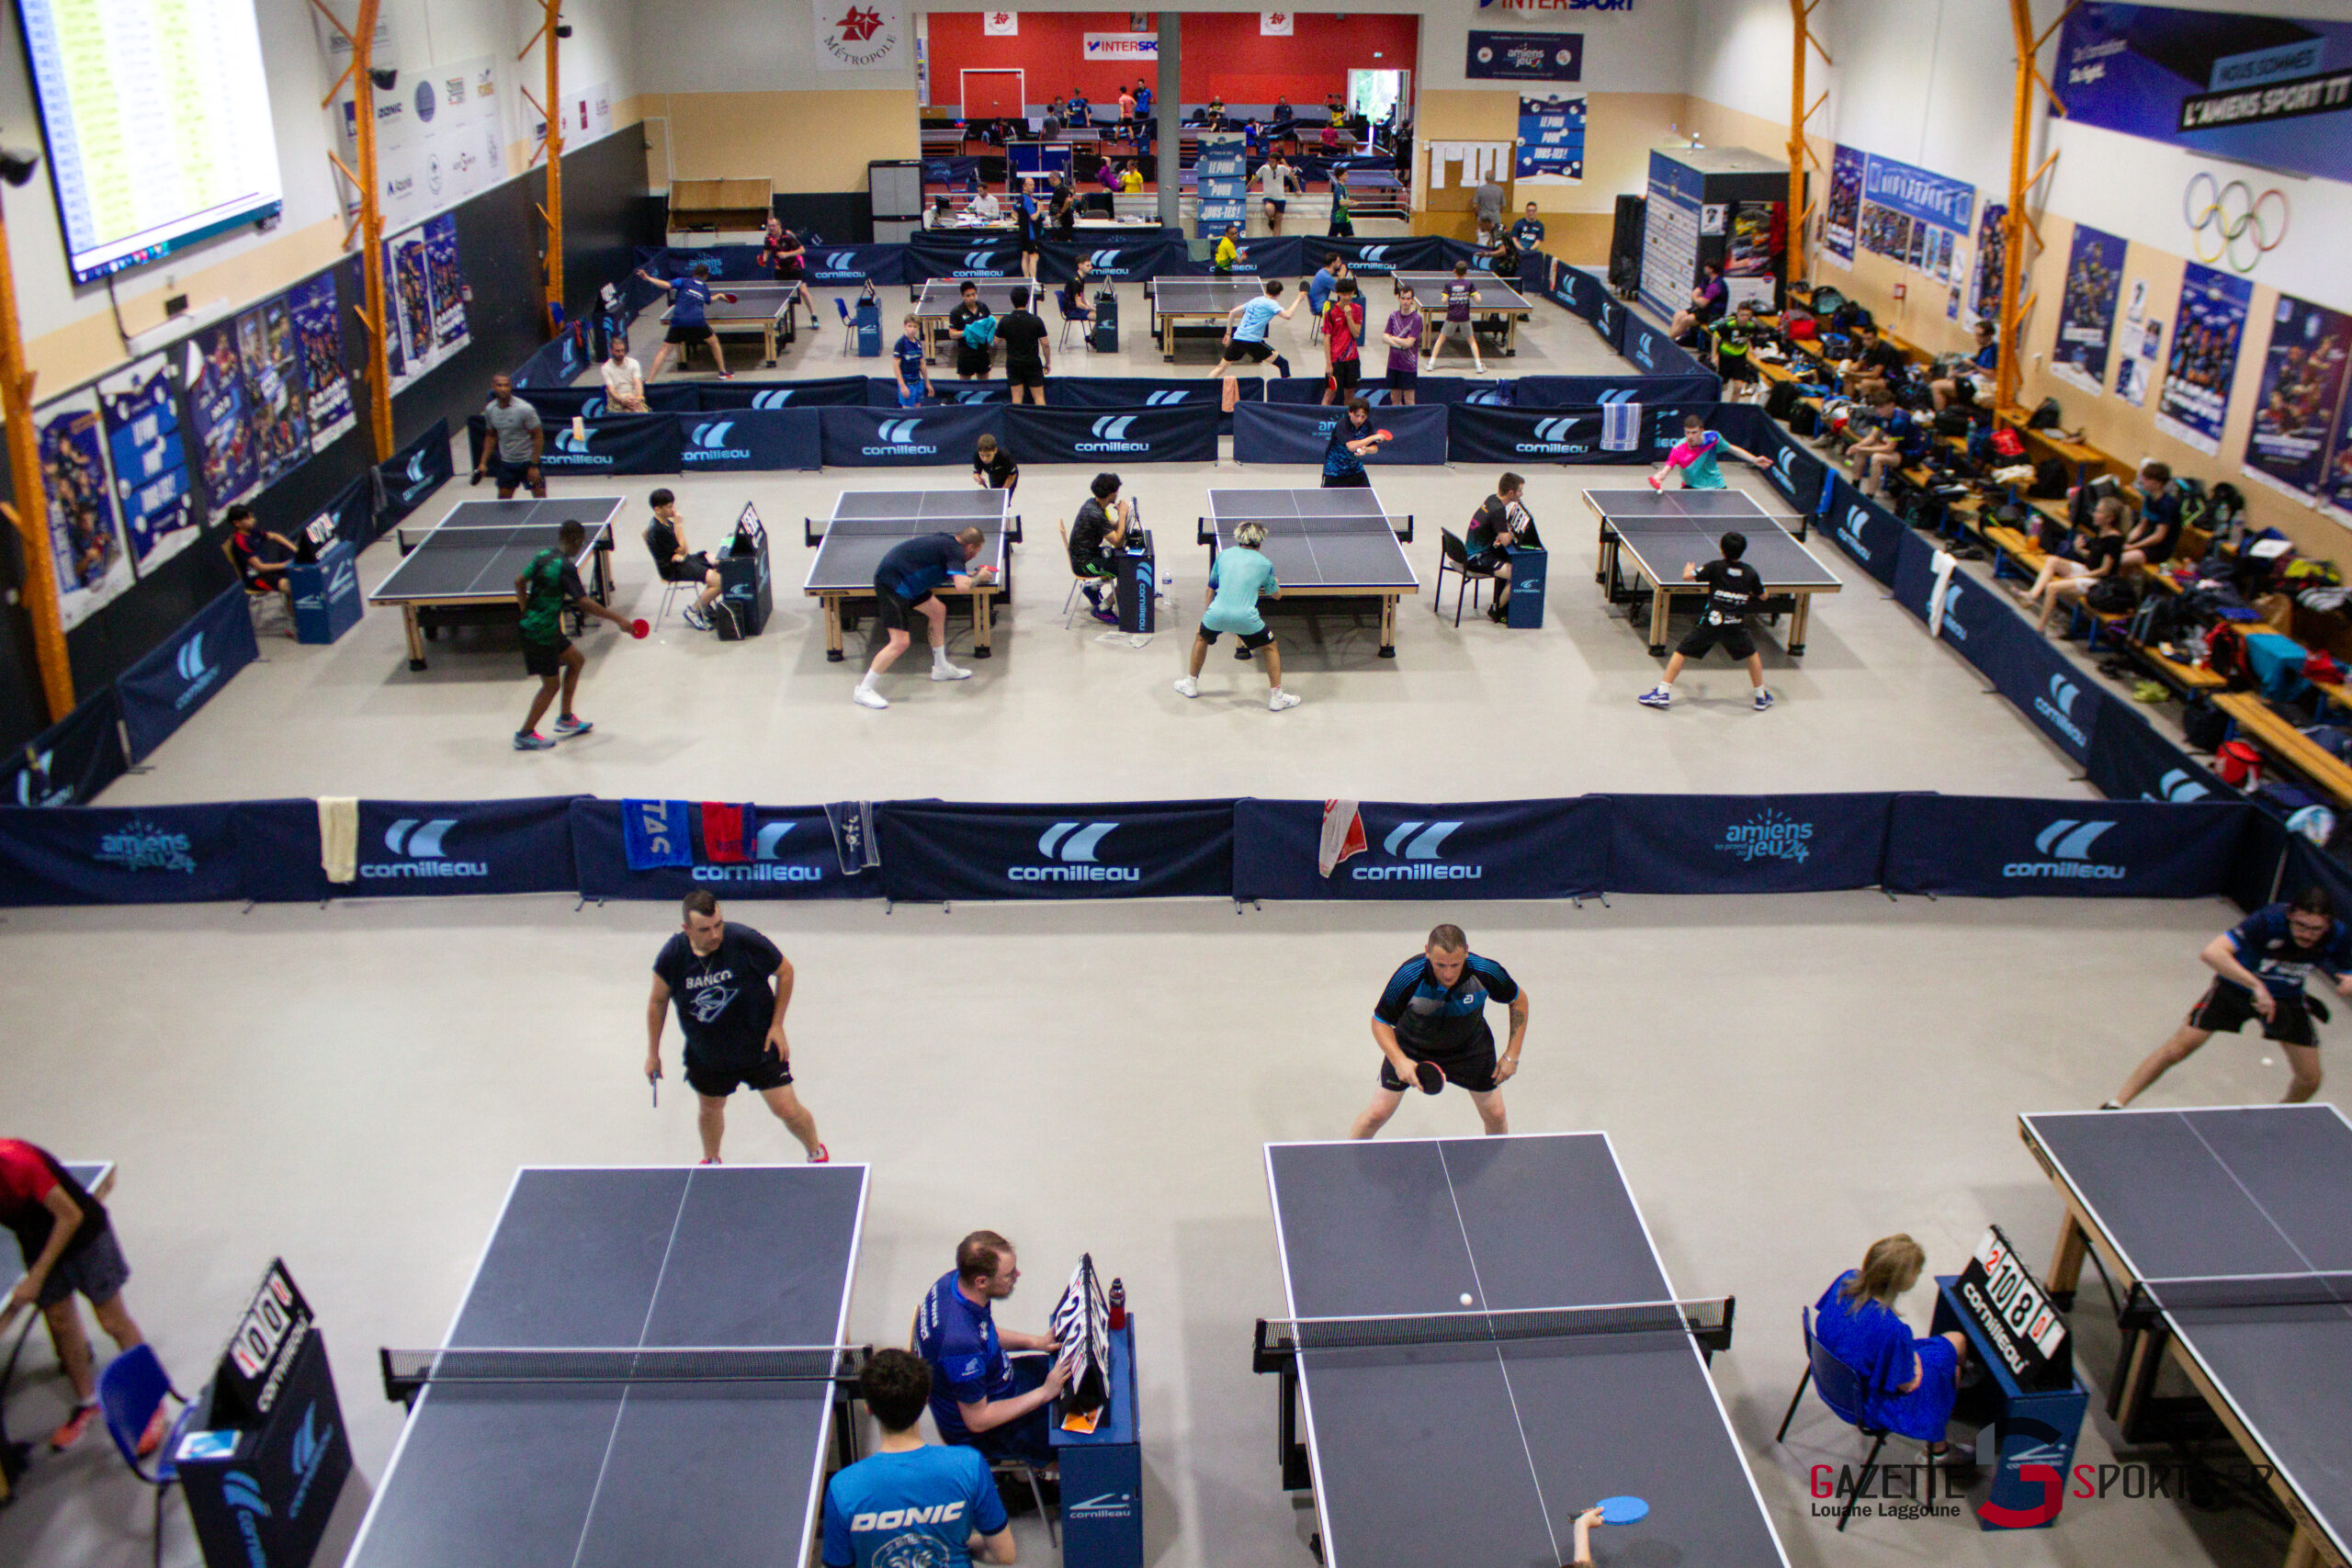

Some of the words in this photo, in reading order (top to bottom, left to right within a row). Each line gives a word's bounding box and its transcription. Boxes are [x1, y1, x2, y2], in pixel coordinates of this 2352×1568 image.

[1501, 0, 1633, 12] INTERSPORT
[824, 35, 897, 65] MÉTROPOLE
[2262, 78, 2323, 114] SPORT
[815, 271, 865, 279] cornilleau
[953, 269, 1003, 278] cornilleau
[1348, 262, 1396, 270] cornilleau
[862, 445, 937, 456] cornilleau
[1074, 442, 1149, 452] cornilleau
[1515, 442, 1589, 454] cornilleau
[1138, 582, 1147, 631] cornilleau
[2034, 696, 2086, 748] cornilleau
[1725, 819, 1814, 842] amiens
[101, 832, 191, 854] amiens
[359, 861, 488, 877] cornilleau
[692, 863, 821, 881] cornilleau
[1008, 865, 1139, 881] cornilleau
[1352, 863, 1482, 880] cornilleau
[2002, 862, 2126, 879] cornilleau
[685, 970, 732, 989] BANCO
[1984, 1249, 1999, 1273] 2
[1990, 1265, 2017, 1303] 10
[2010, 1292, 2033, 1328] 8
[1962, 1281, 2026, 1375] cornilleau
[850, 1500, 967, 1532] DONIC
[1069, 1509, 1131, 1519] cornilleau
